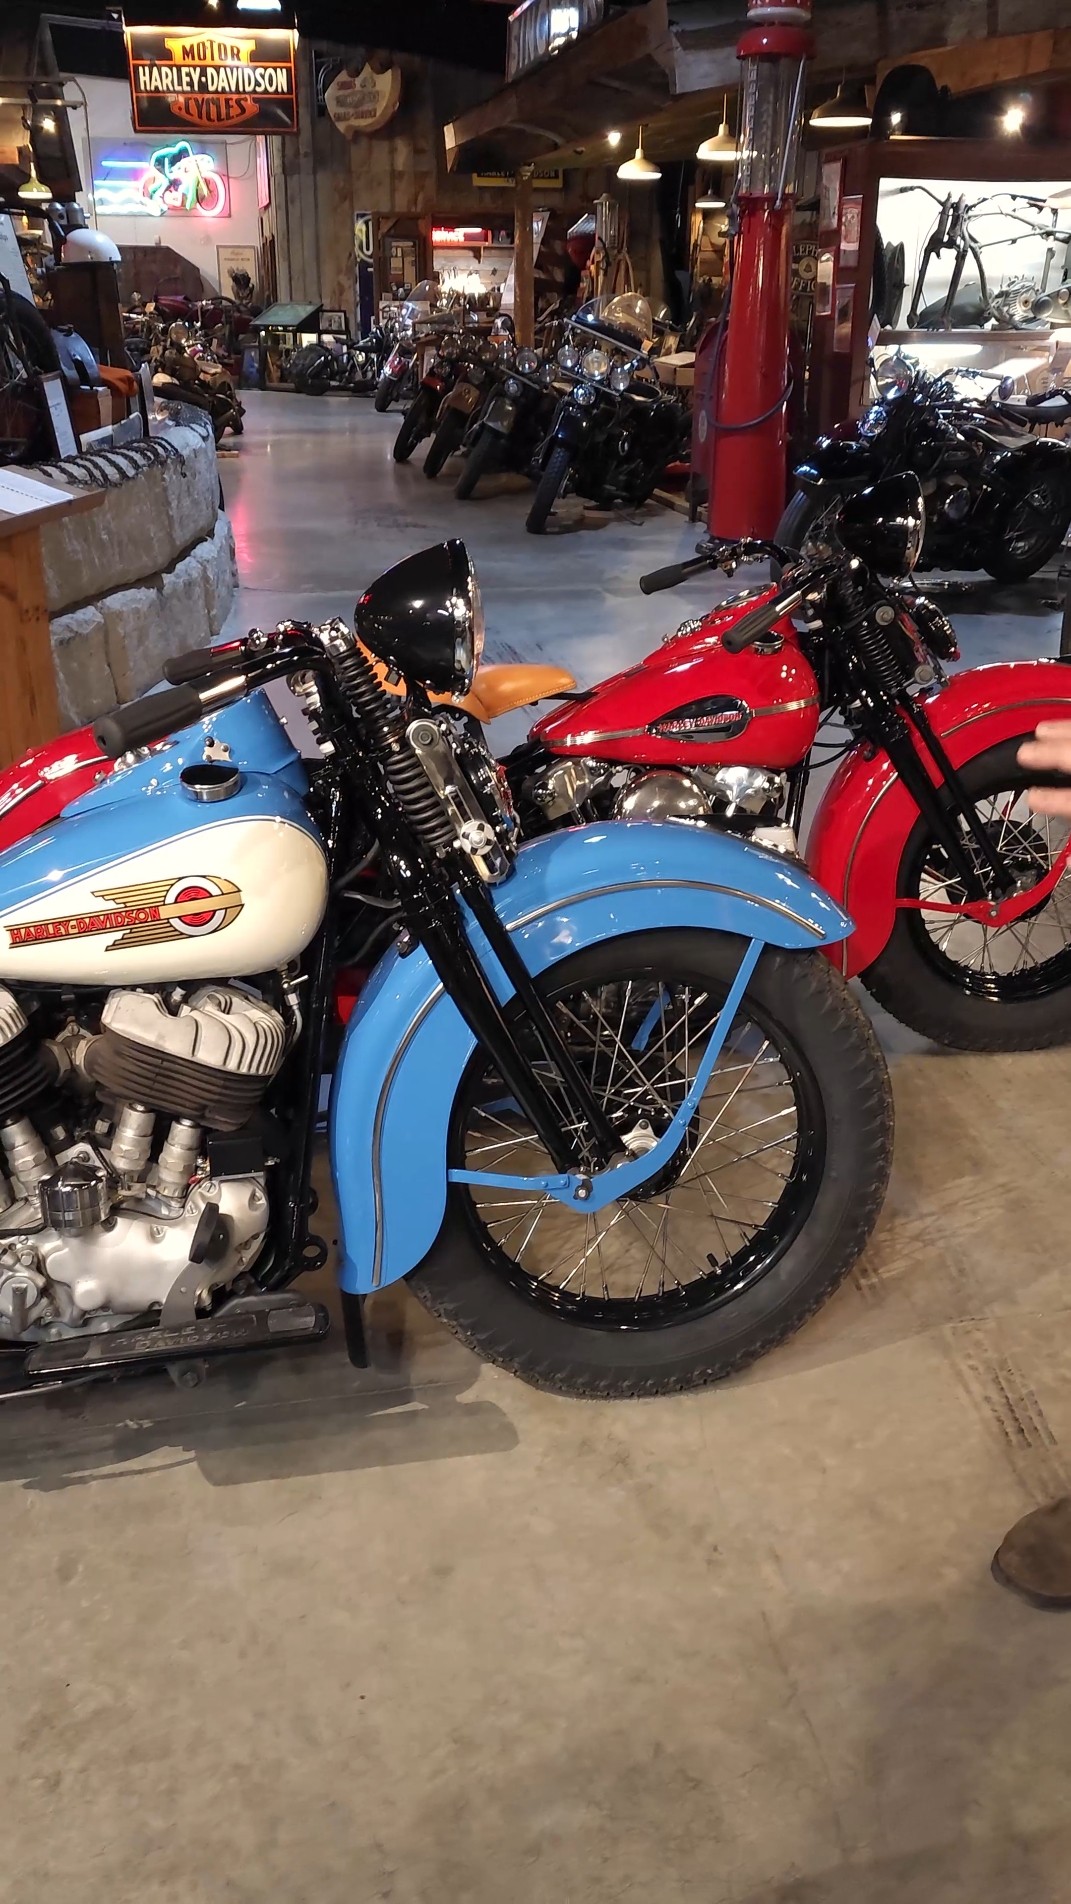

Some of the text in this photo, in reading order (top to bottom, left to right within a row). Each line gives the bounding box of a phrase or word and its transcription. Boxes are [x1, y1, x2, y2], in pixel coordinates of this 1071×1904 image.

[181, 39, 242, 62] MOTOR
[138, 65, 288, 93] HARLEY-DAVIDSON
[183, 95, 249, 123] CYCLES
[9, 906, 162, 944] HARLEY-DAVIDSON
